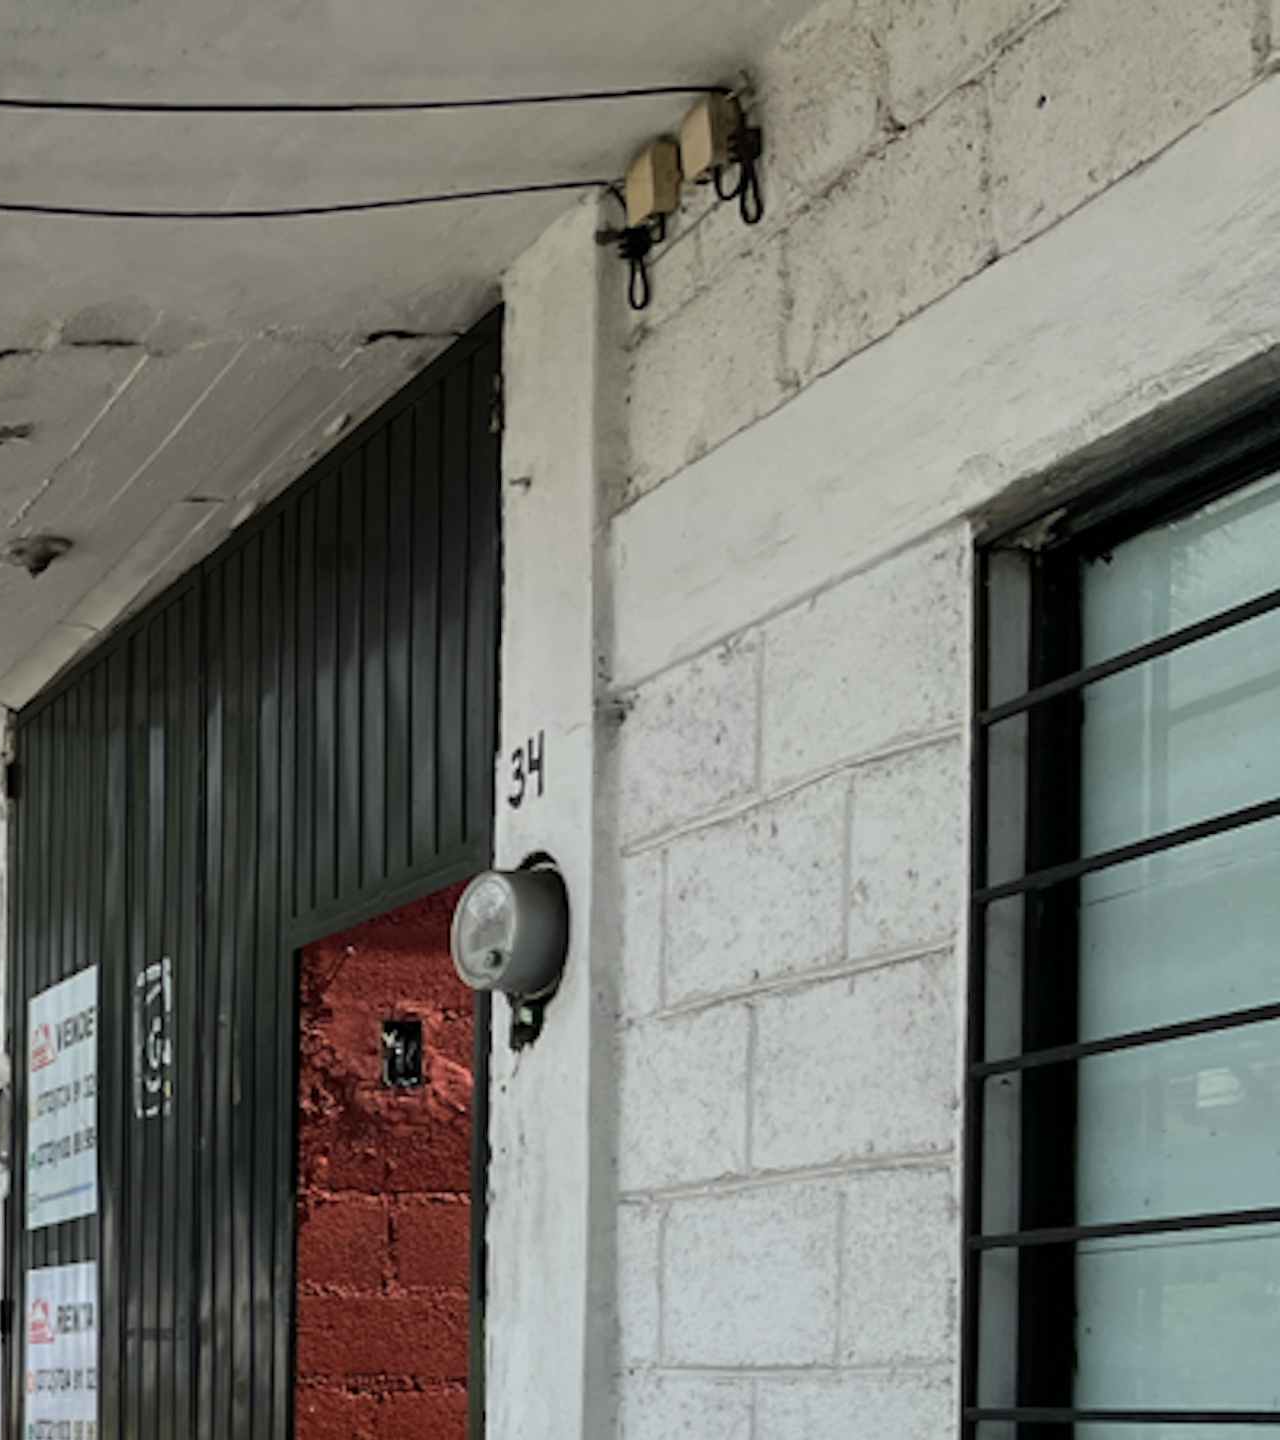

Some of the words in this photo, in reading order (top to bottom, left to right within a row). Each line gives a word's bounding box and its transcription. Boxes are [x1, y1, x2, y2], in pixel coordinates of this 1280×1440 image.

[507, 730, 545, 810] 34
[56, 1005, 96, 1055] VENDE
[56, 1302, 94, 1335] RENTA
